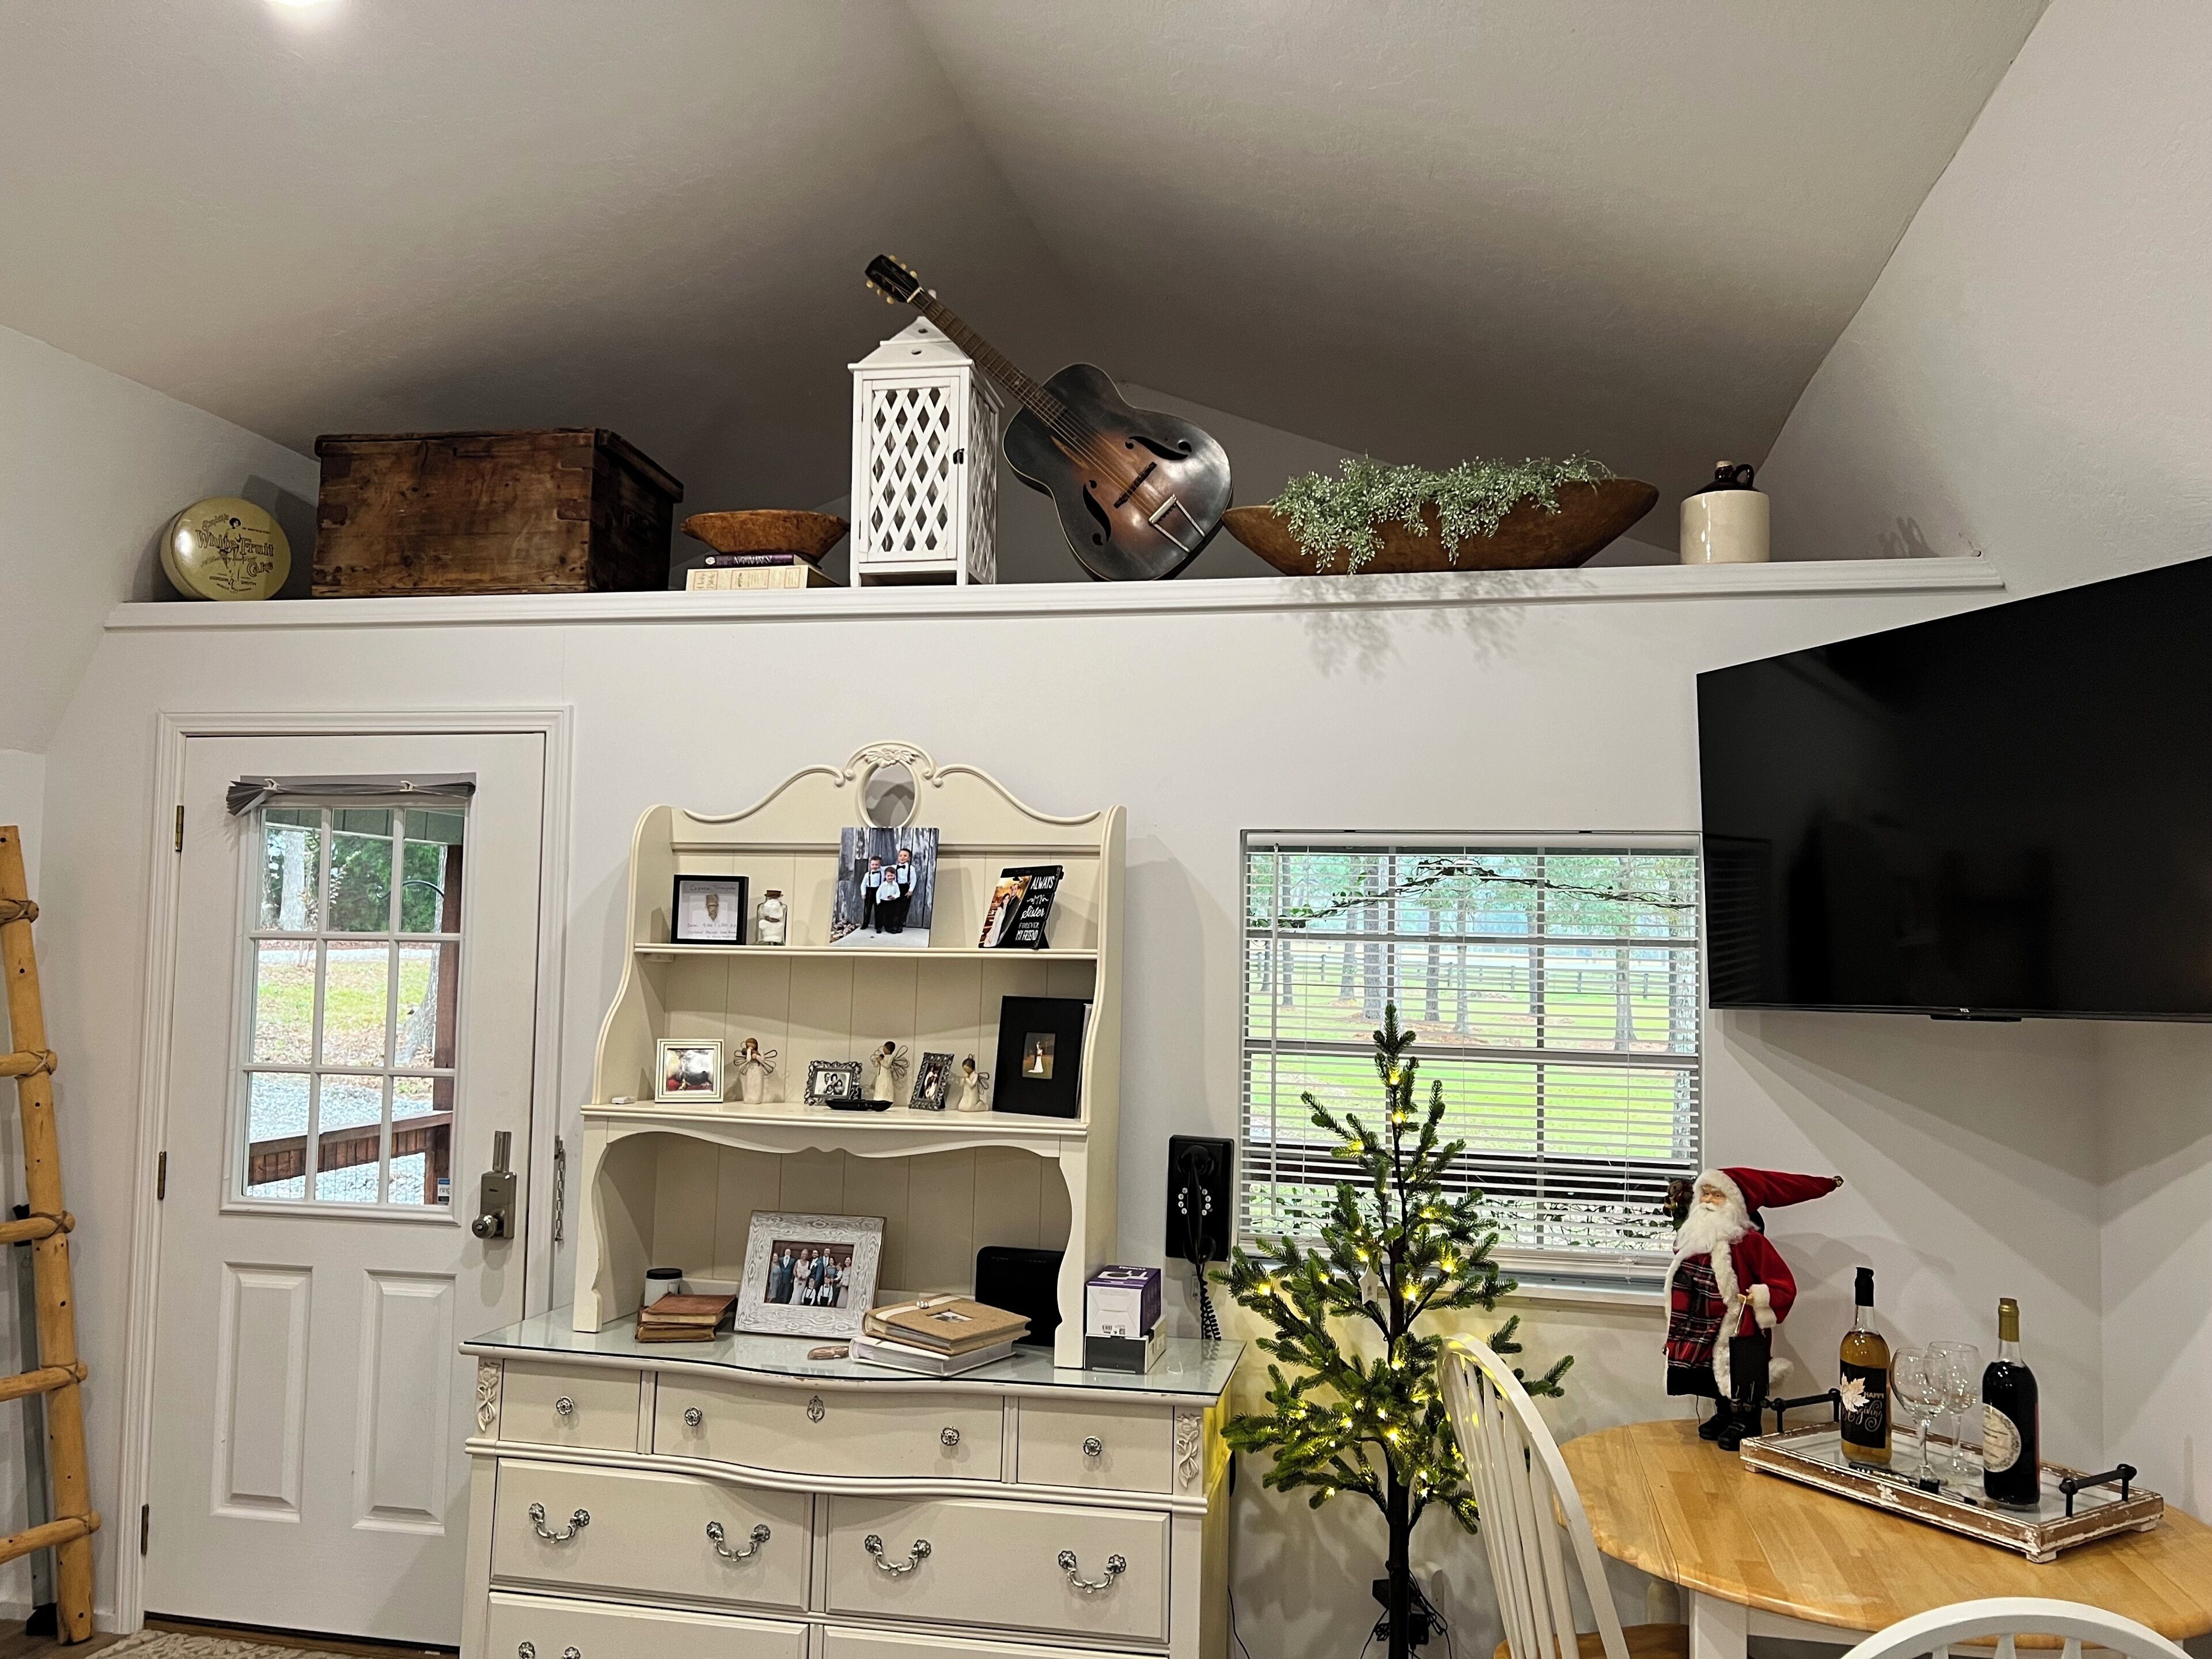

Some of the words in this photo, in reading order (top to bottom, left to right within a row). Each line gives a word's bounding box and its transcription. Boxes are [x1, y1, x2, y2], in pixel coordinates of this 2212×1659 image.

[195, 530, 238, 553] White
[240, 537, 274, 557] Fruit
[247, 562, 274, 577] Cake
[1030, 876, 1055, 889] ALWAYS
[1032, 895, 1046, 904] MY
[1020, 906, 1045, 921] Sister
[1015, 930, 1024, 941] MY
[1022, 930, 1039, 941] FRIEND
